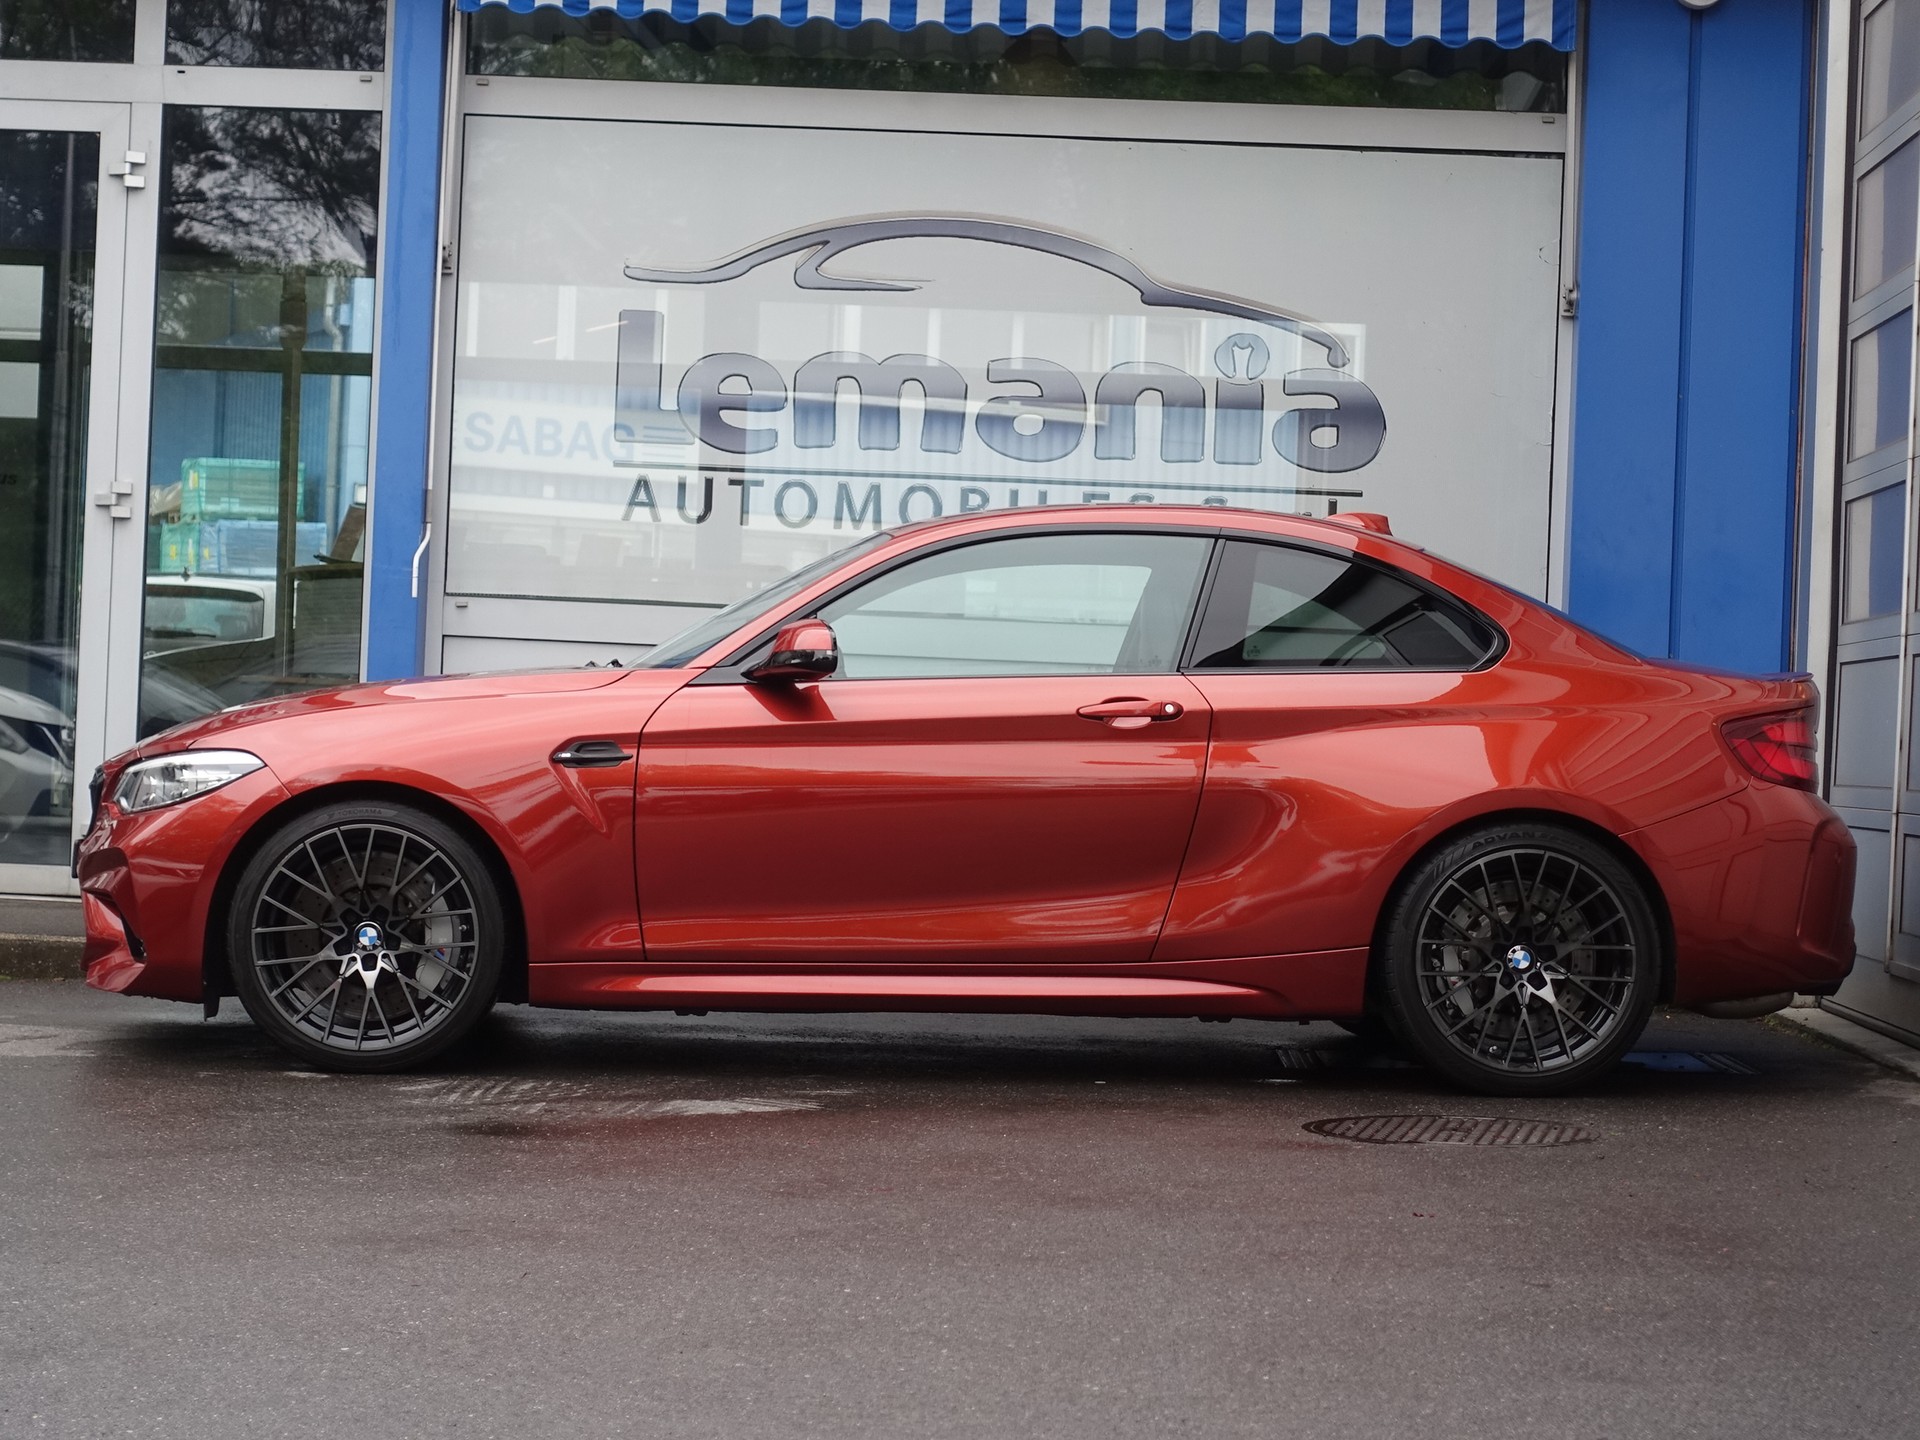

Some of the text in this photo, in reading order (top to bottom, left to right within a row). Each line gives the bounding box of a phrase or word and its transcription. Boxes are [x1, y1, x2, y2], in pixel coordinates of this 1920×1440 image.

[613, 308, 1387, 473] Lemania
[463, 410, 636, 462] SABAG
[620, 473, 1155, 531] AUTOMOB
[1472, 831, 1536, 849] ADVAN
